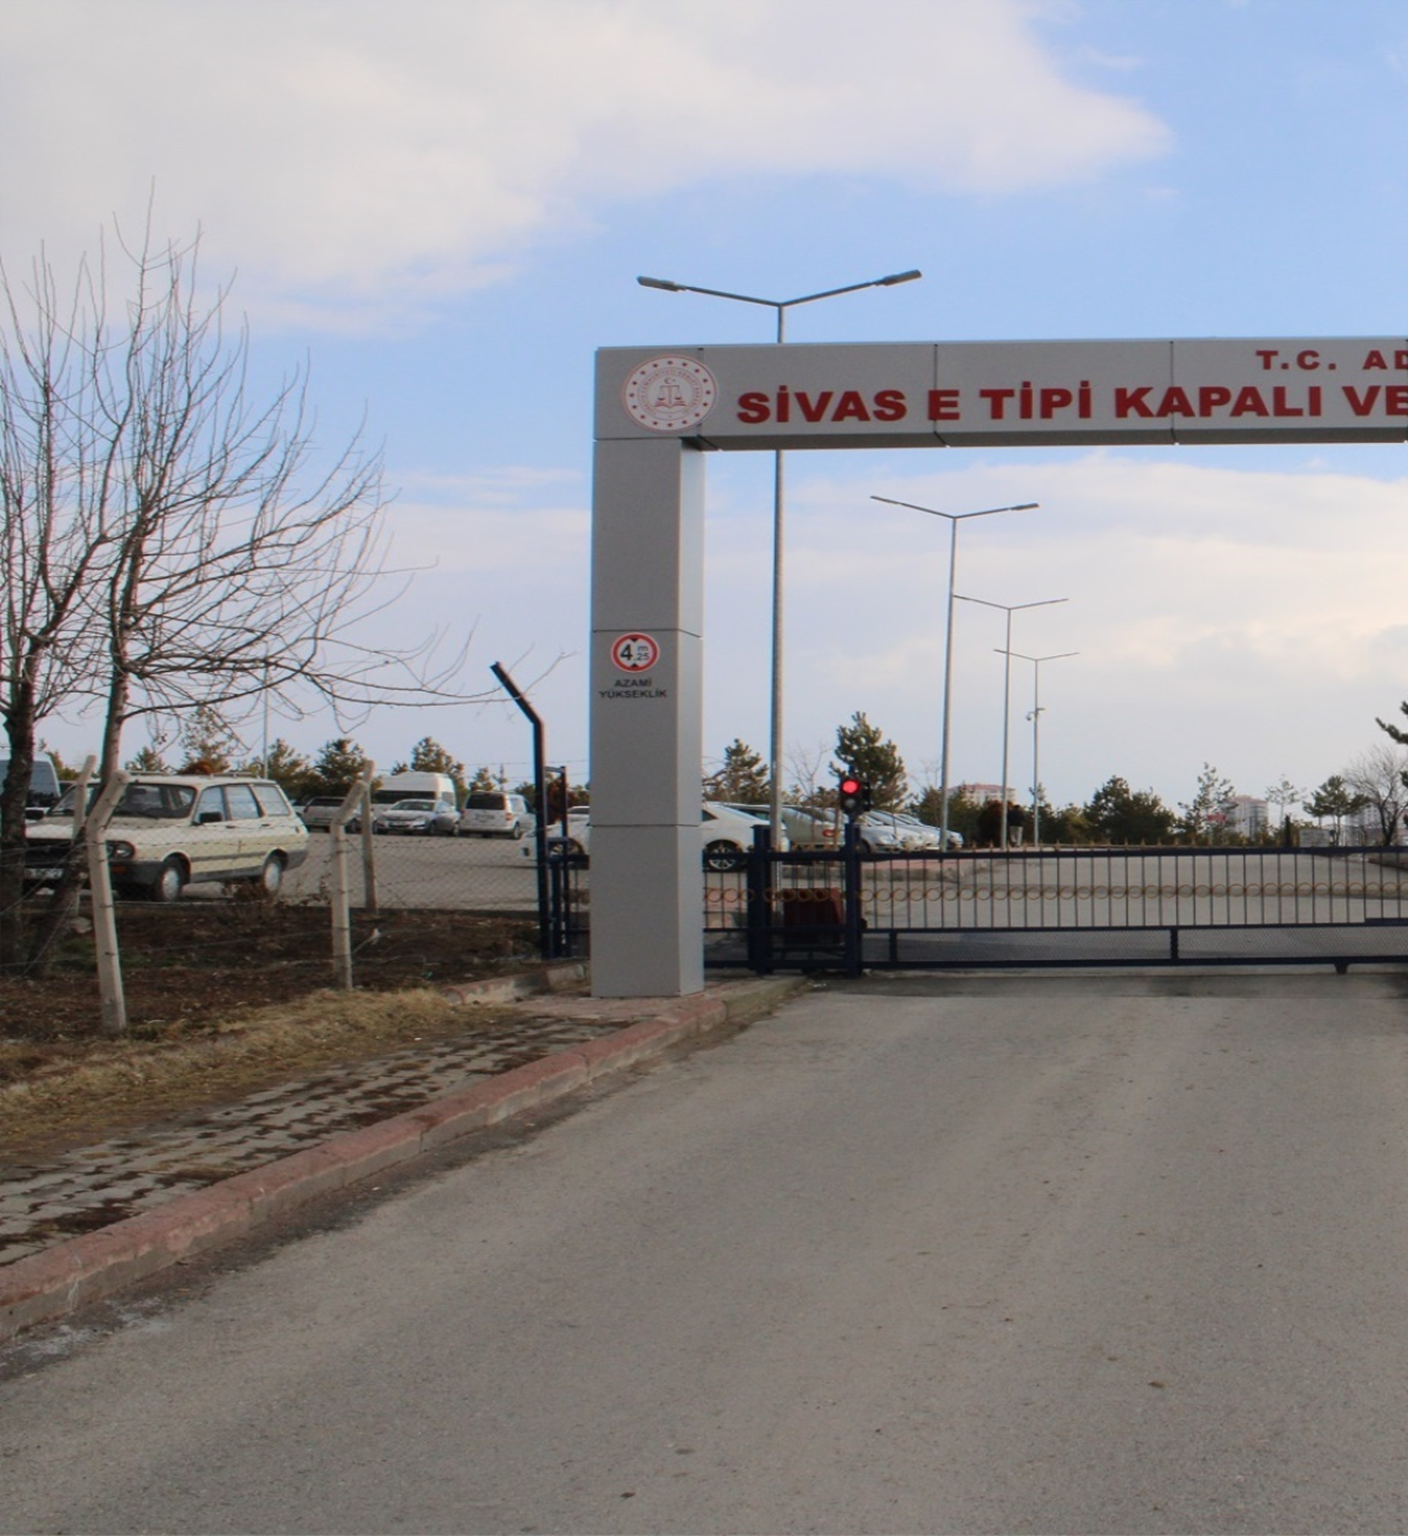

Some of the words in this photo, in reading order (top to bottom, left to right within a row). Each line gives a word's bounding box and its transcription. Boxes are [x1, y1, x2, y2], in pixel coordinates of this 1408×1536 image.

[1257, 350, 1336, 371] T.C.
[738, 385, 908, 425] SİVAS
[927, 388, 962, 422] E
[979, 380, 1094, 421] TİPİ
[1114, 385, 1324, 419] KAPALI
[620, 644, 633, 661] 4
[614, 677, 655, 687] AZAMİ
[599, 688, 667, 698] YÜKSEKLİK
